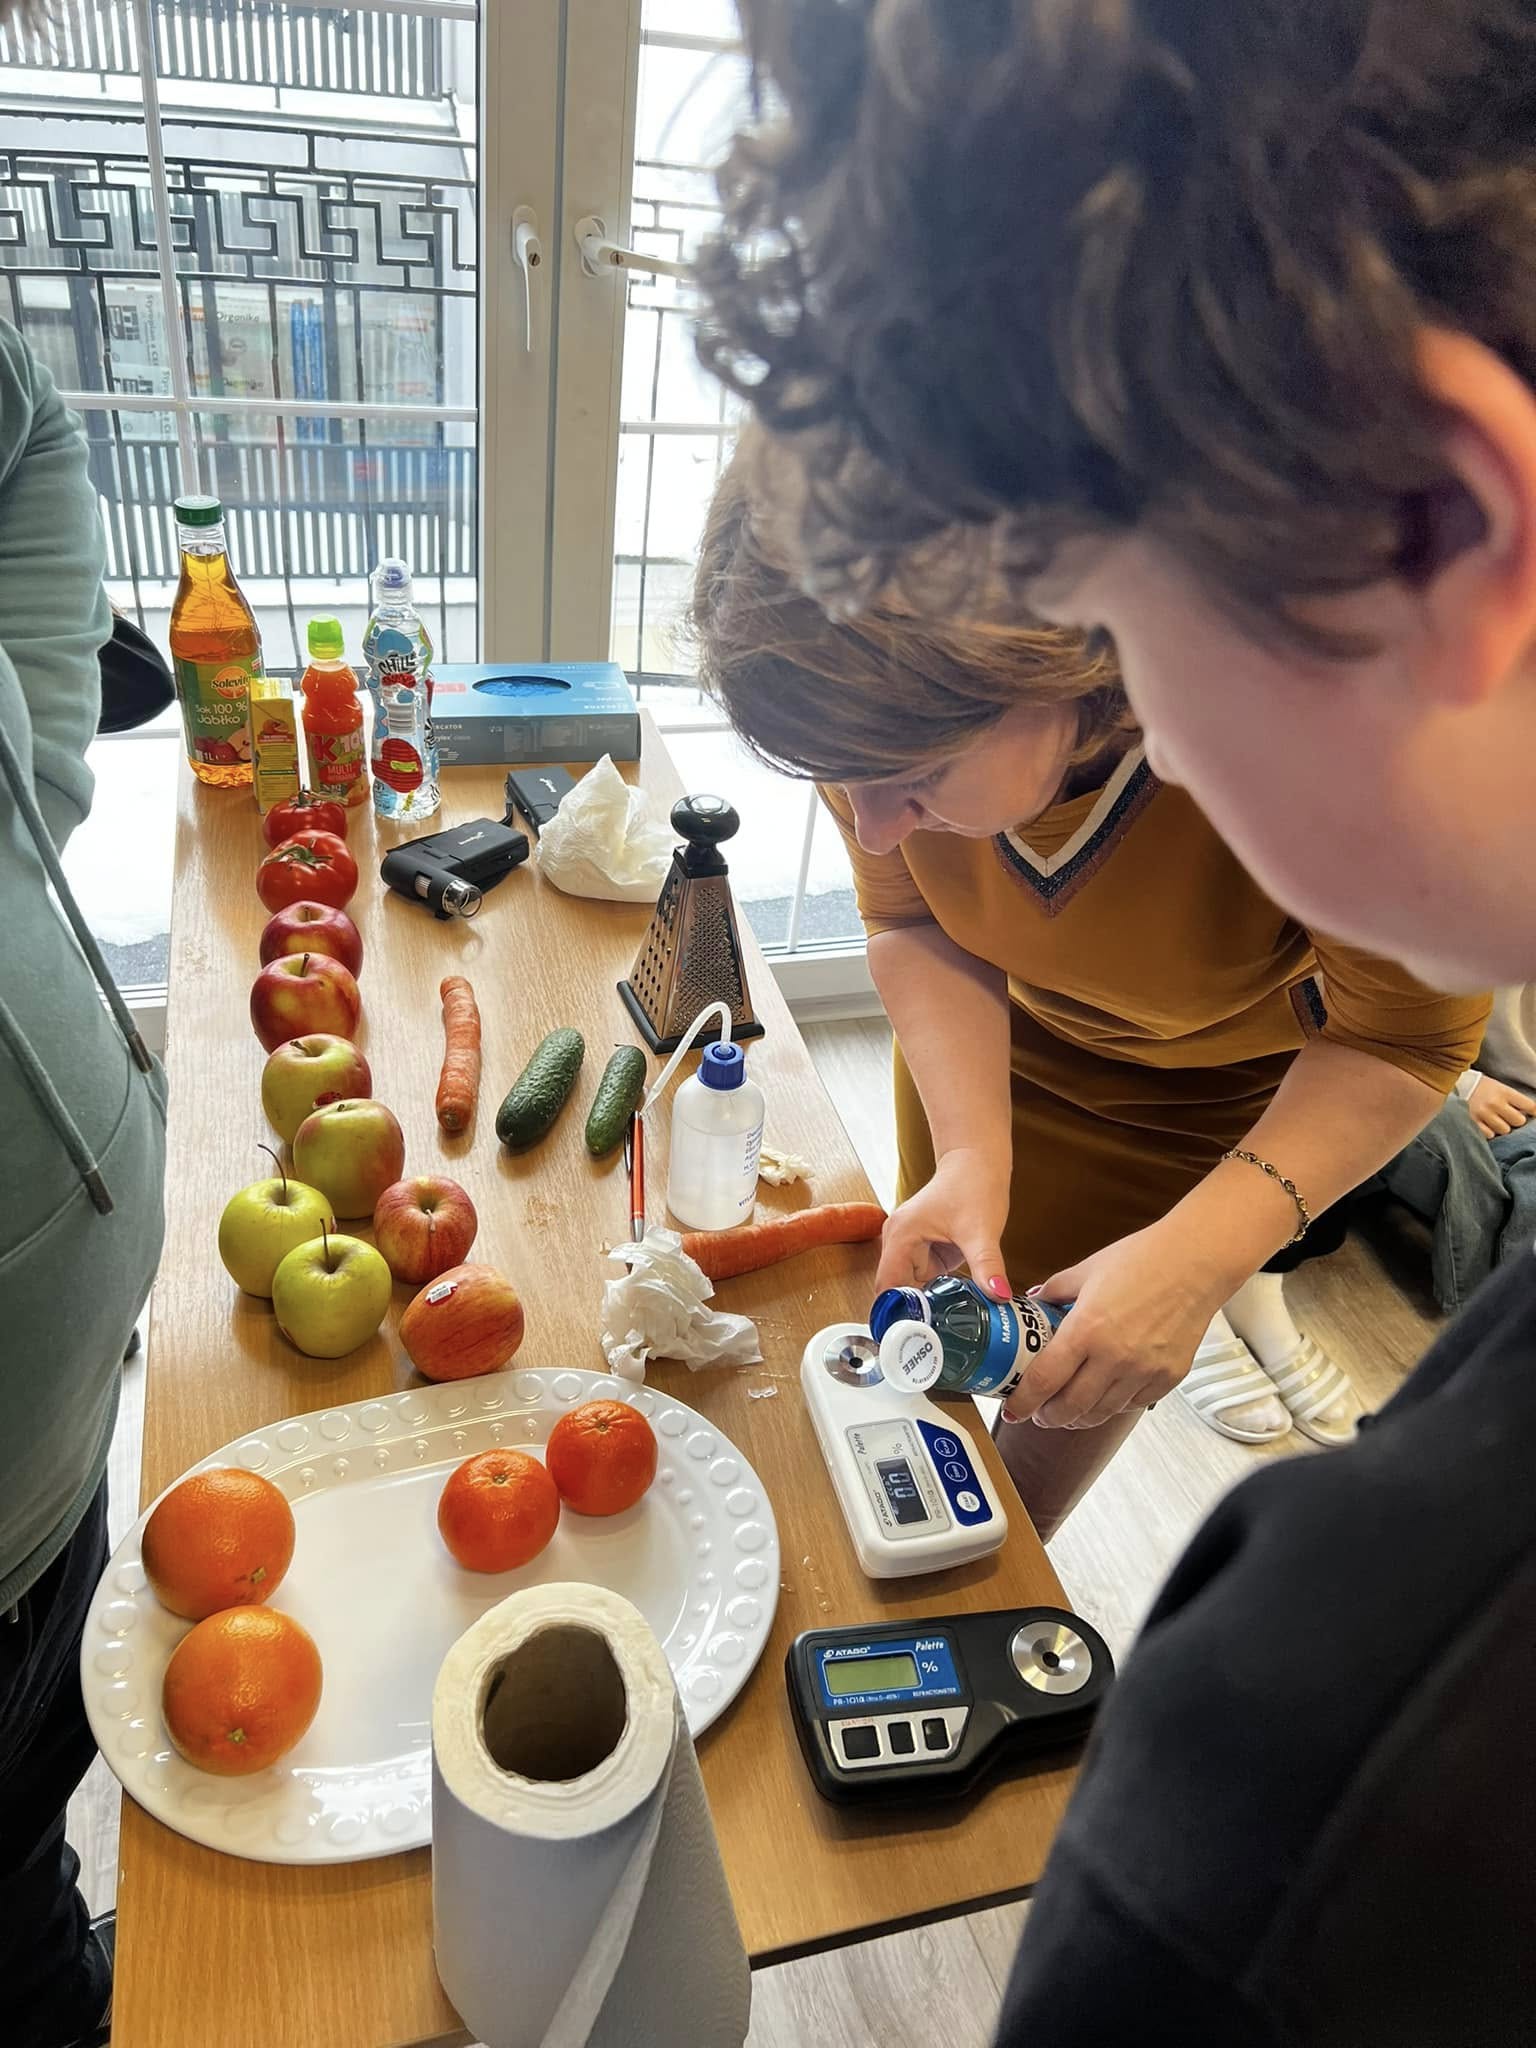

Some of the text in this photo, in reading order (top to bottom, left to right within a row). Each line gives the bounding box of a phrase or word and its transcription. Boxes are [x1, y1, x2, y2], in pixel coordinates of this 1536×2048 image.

[213, 703, 232, 715] 100
[902, 1341, 933, 1376] OSHEE
[915, 1641, 944, 1651] Palette
[921, 1661, 939, 1673] %
